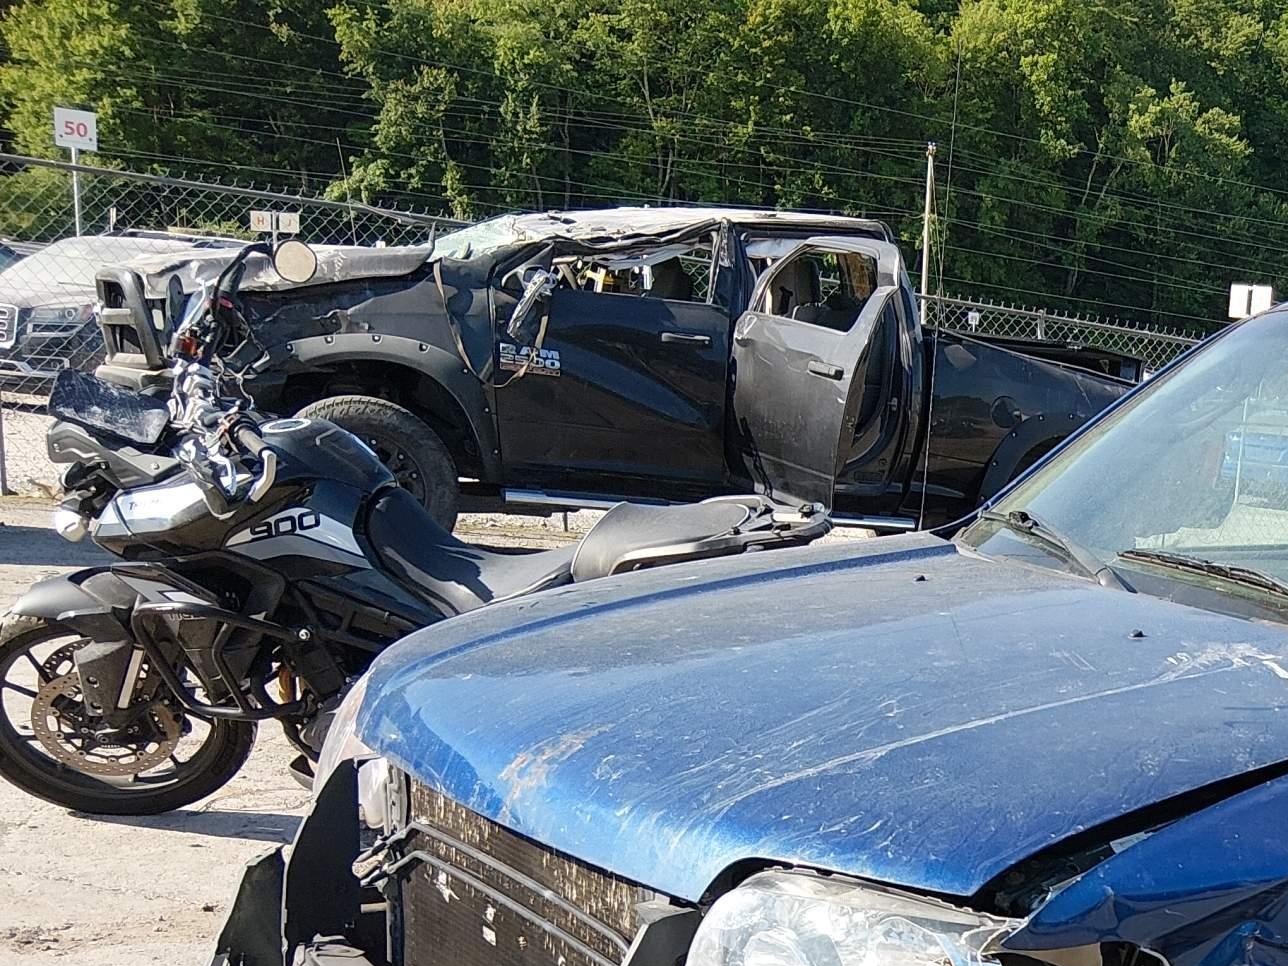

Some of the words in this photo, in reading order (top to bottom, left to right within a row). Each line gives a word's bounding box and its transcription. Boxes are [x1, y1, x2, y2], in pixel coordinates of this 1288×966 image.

[64, 120, 88, 138] 50
[257, 216, 265, 226] H
[499, 342, 560, 360] RAM
[249, 511, 321, 543] 900
